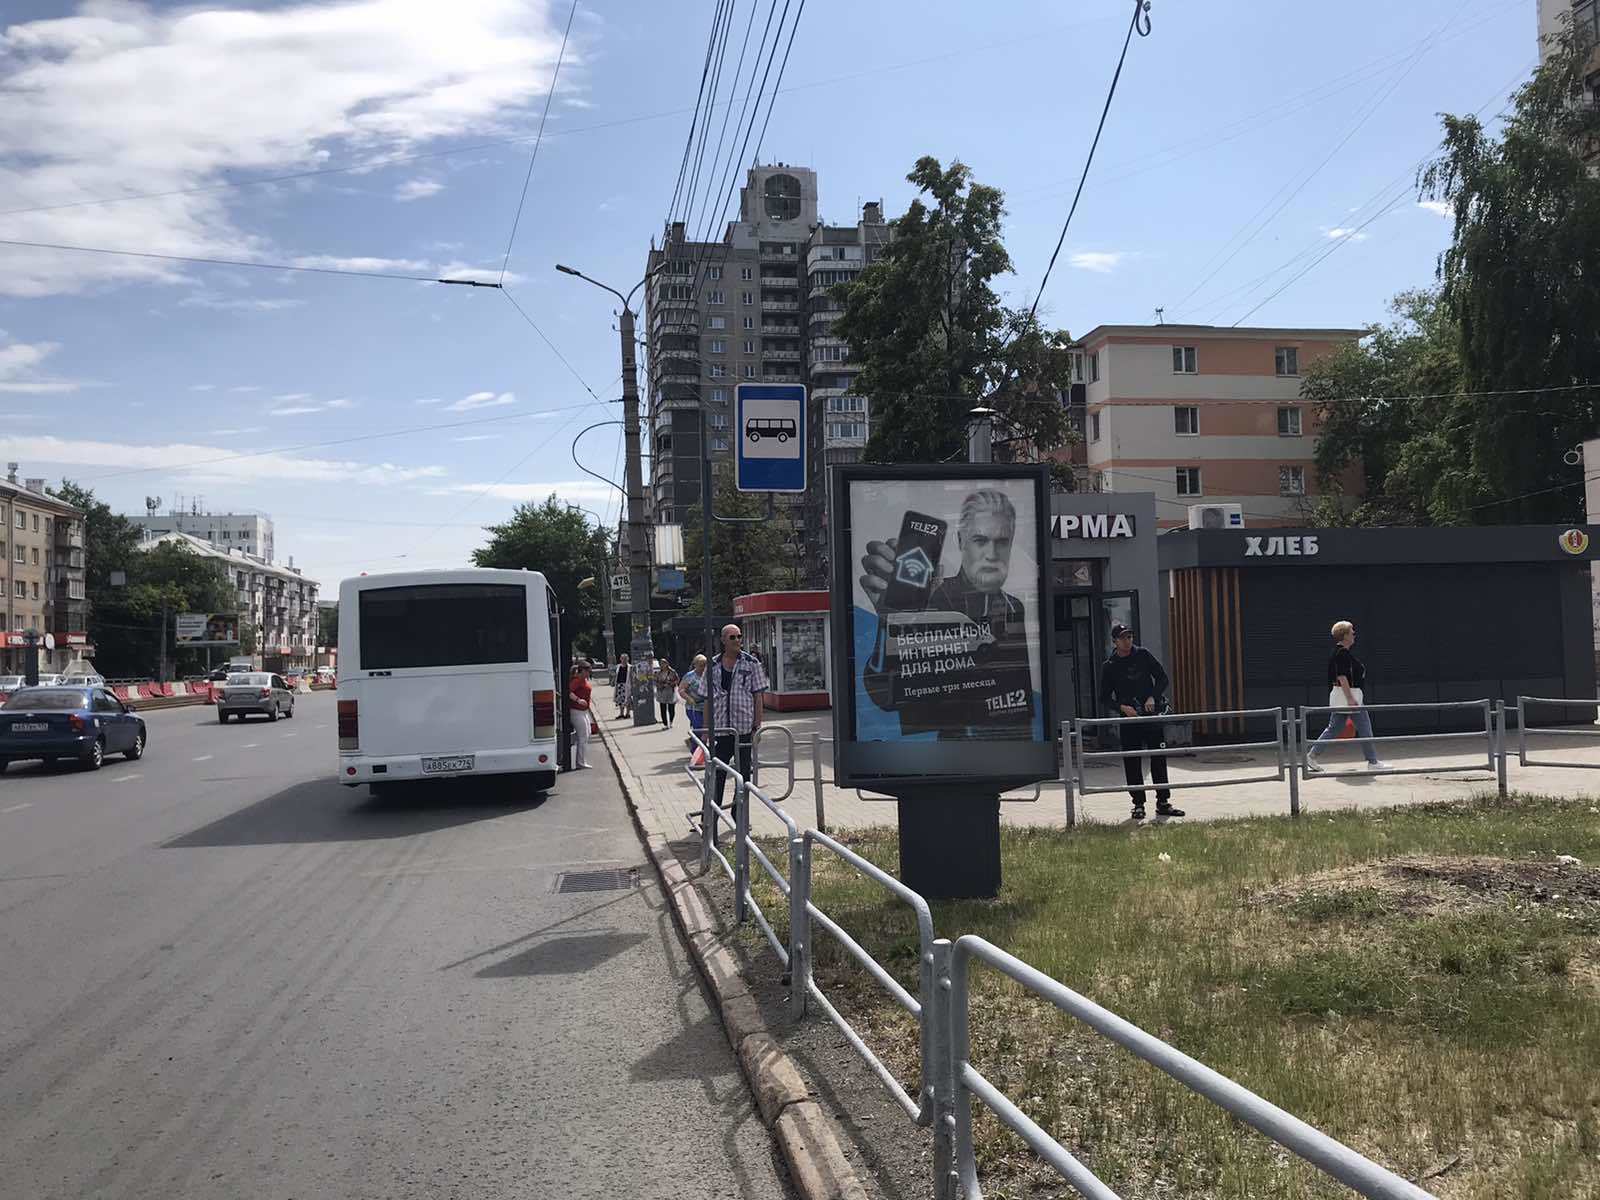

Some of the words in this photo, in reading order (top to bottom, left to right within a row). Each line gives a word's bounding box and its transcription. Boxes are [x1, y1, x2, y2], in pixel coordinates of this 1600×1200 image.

[910, 518, 938, 536] TELE2
[1245, 535, 1319, 556] ХЛЕБ
[897, 622, 992, 646] БЕСПЛАТНЫЙ
[898, 641, 969, 661] ИНТЕРНЕТ
[900, 662, 931, 678] ДЛЯ
[934, 656, 976, 674] ДОМА
[904, 685, 940, 697] Первые
[942, 684, 960, 694] три
[962, 678, 997, 689] месяца
[985, 689, 1027, 711] TELE2
